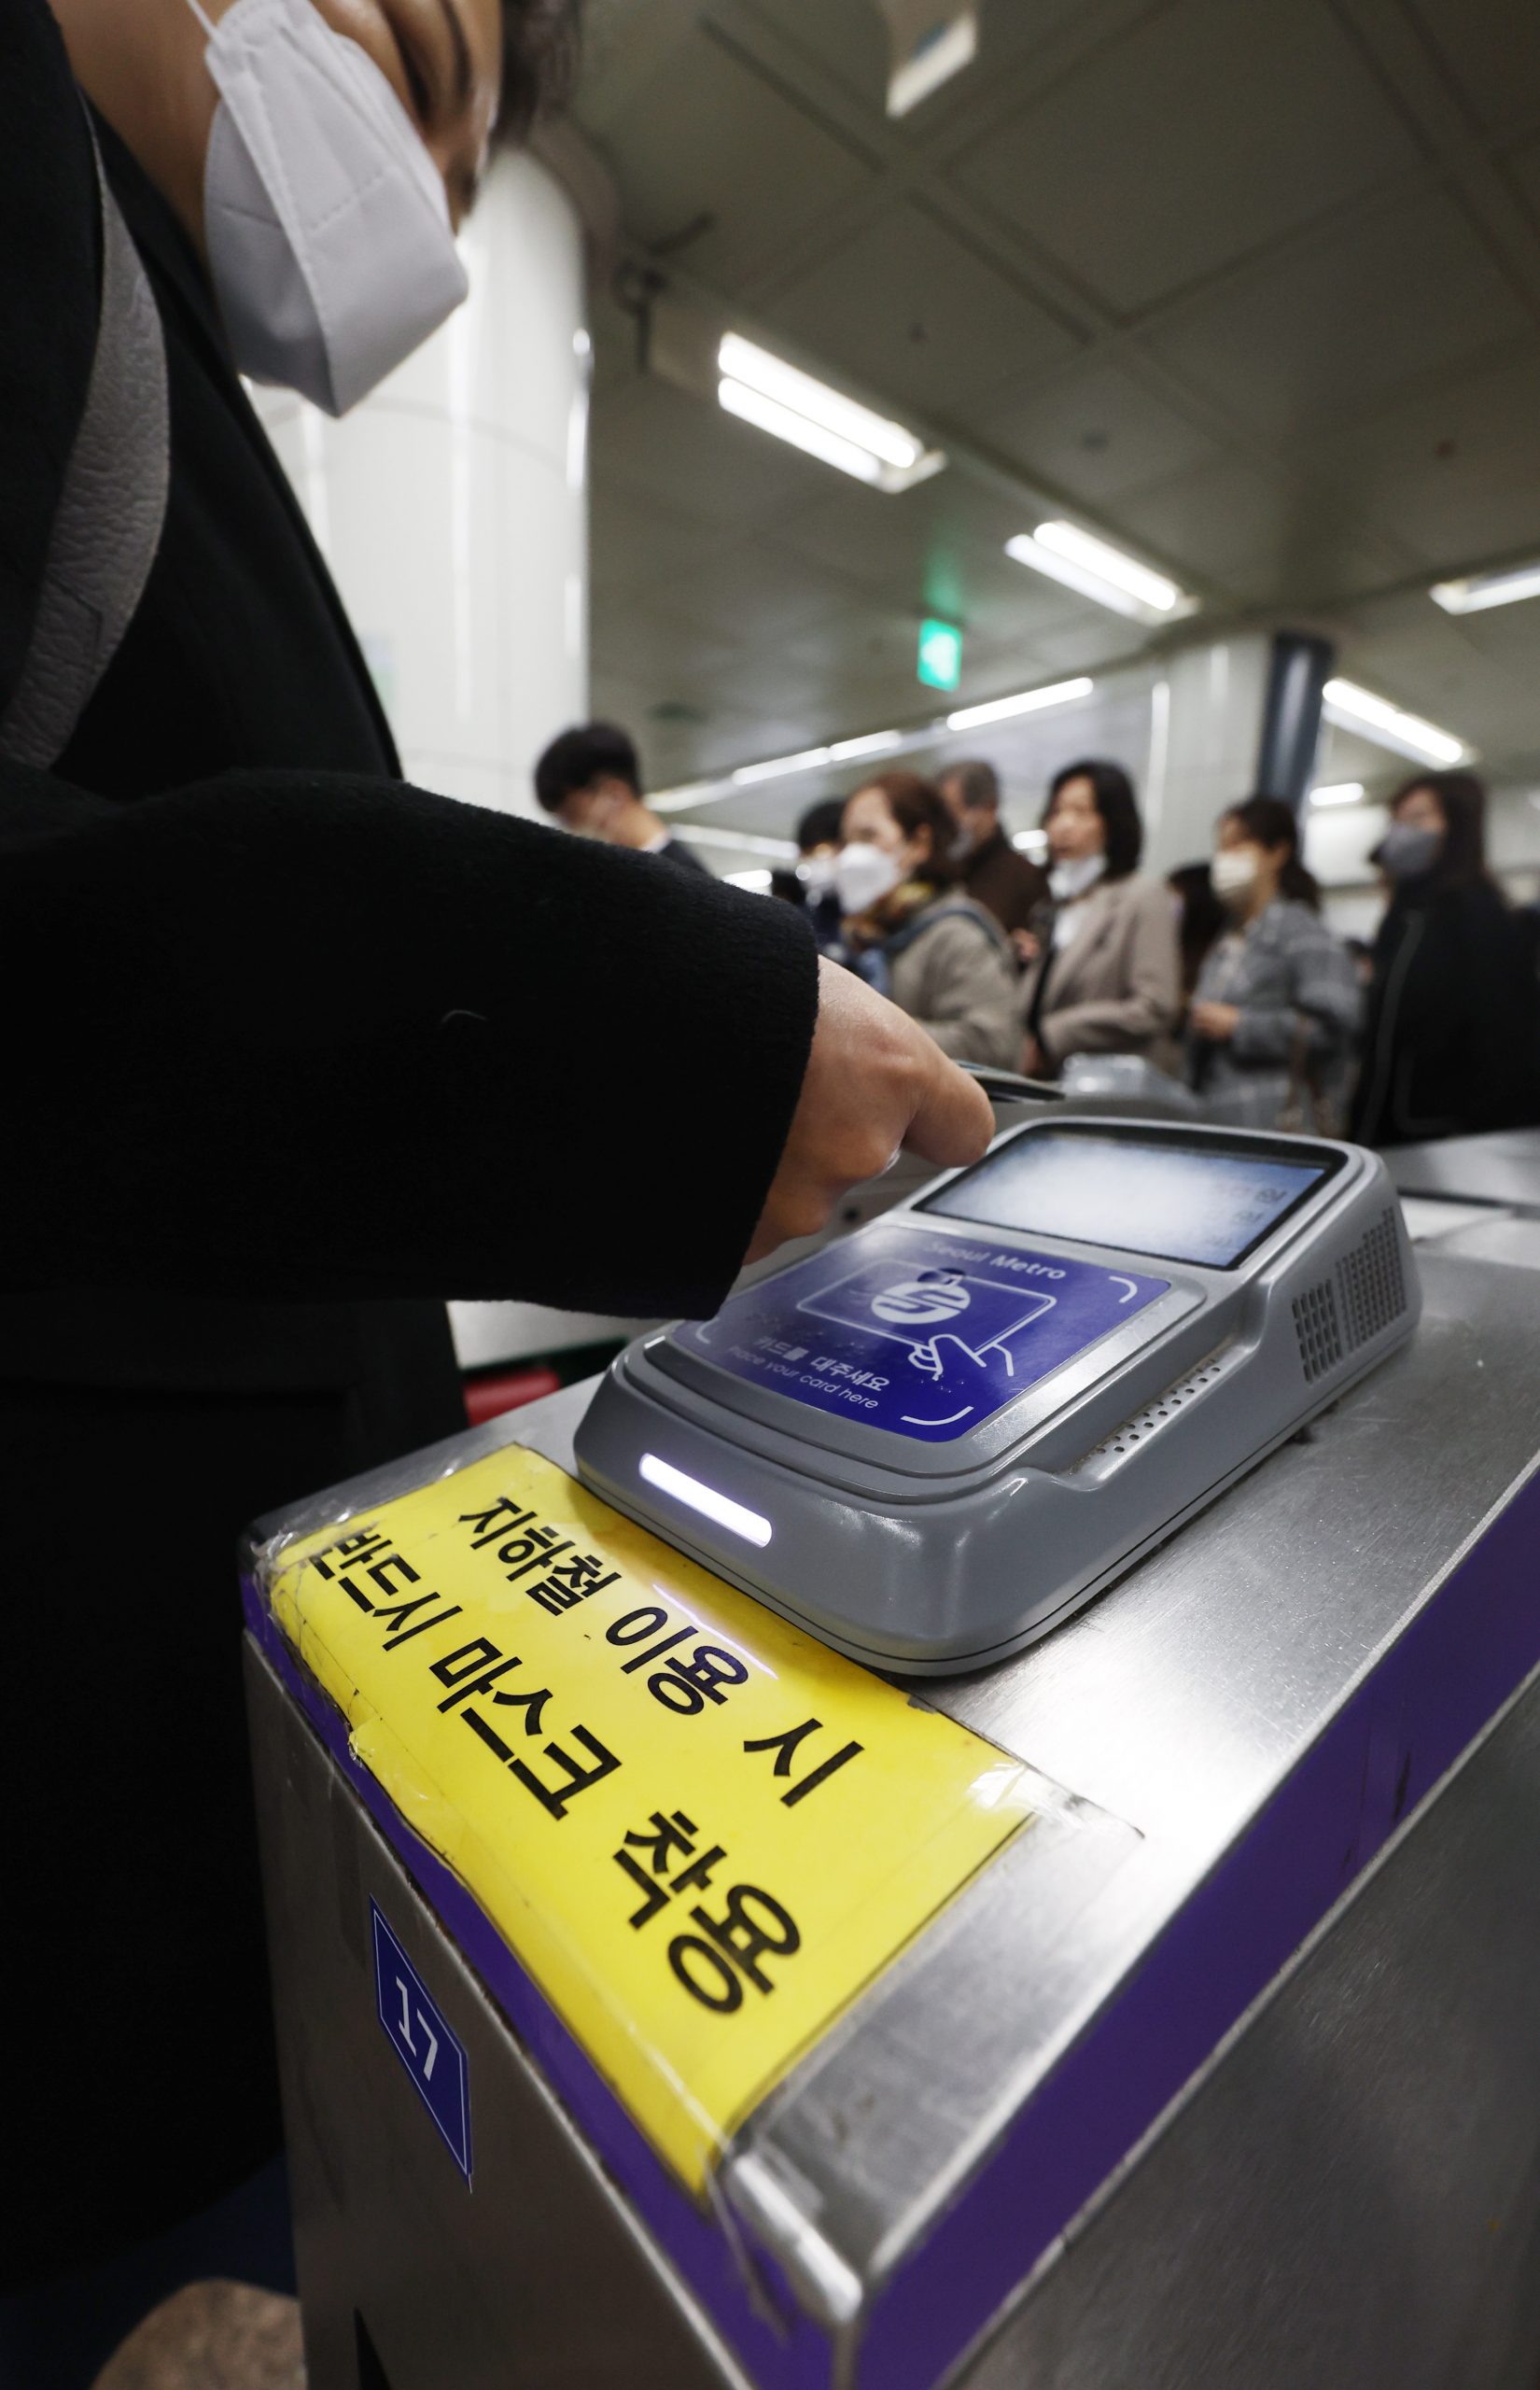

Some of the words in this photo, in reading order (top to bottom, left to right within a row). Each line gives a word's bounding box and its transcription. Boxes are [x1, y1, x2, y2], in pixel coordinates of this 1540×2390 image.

[989, 1254, 1067, 1280] Metro
[764, 1361, 800, 1378] your
[799, 1373, 841, 1394] card
[838, 1387, 879, 1410] here
[810, 1356, 890, 1392] 대주세요
[458, 1497, 623, 1617] 지하철
[605, 1607, 749, 1716] 이용
[743, 1718, 864, 1807] 시
[309, 1527, 464, 1652] 반드시
[428, 1637, 622, 1821] 마스크
[613, 1810, 801, 2016] 착용
[396, 1975, 439, 2082] 17
